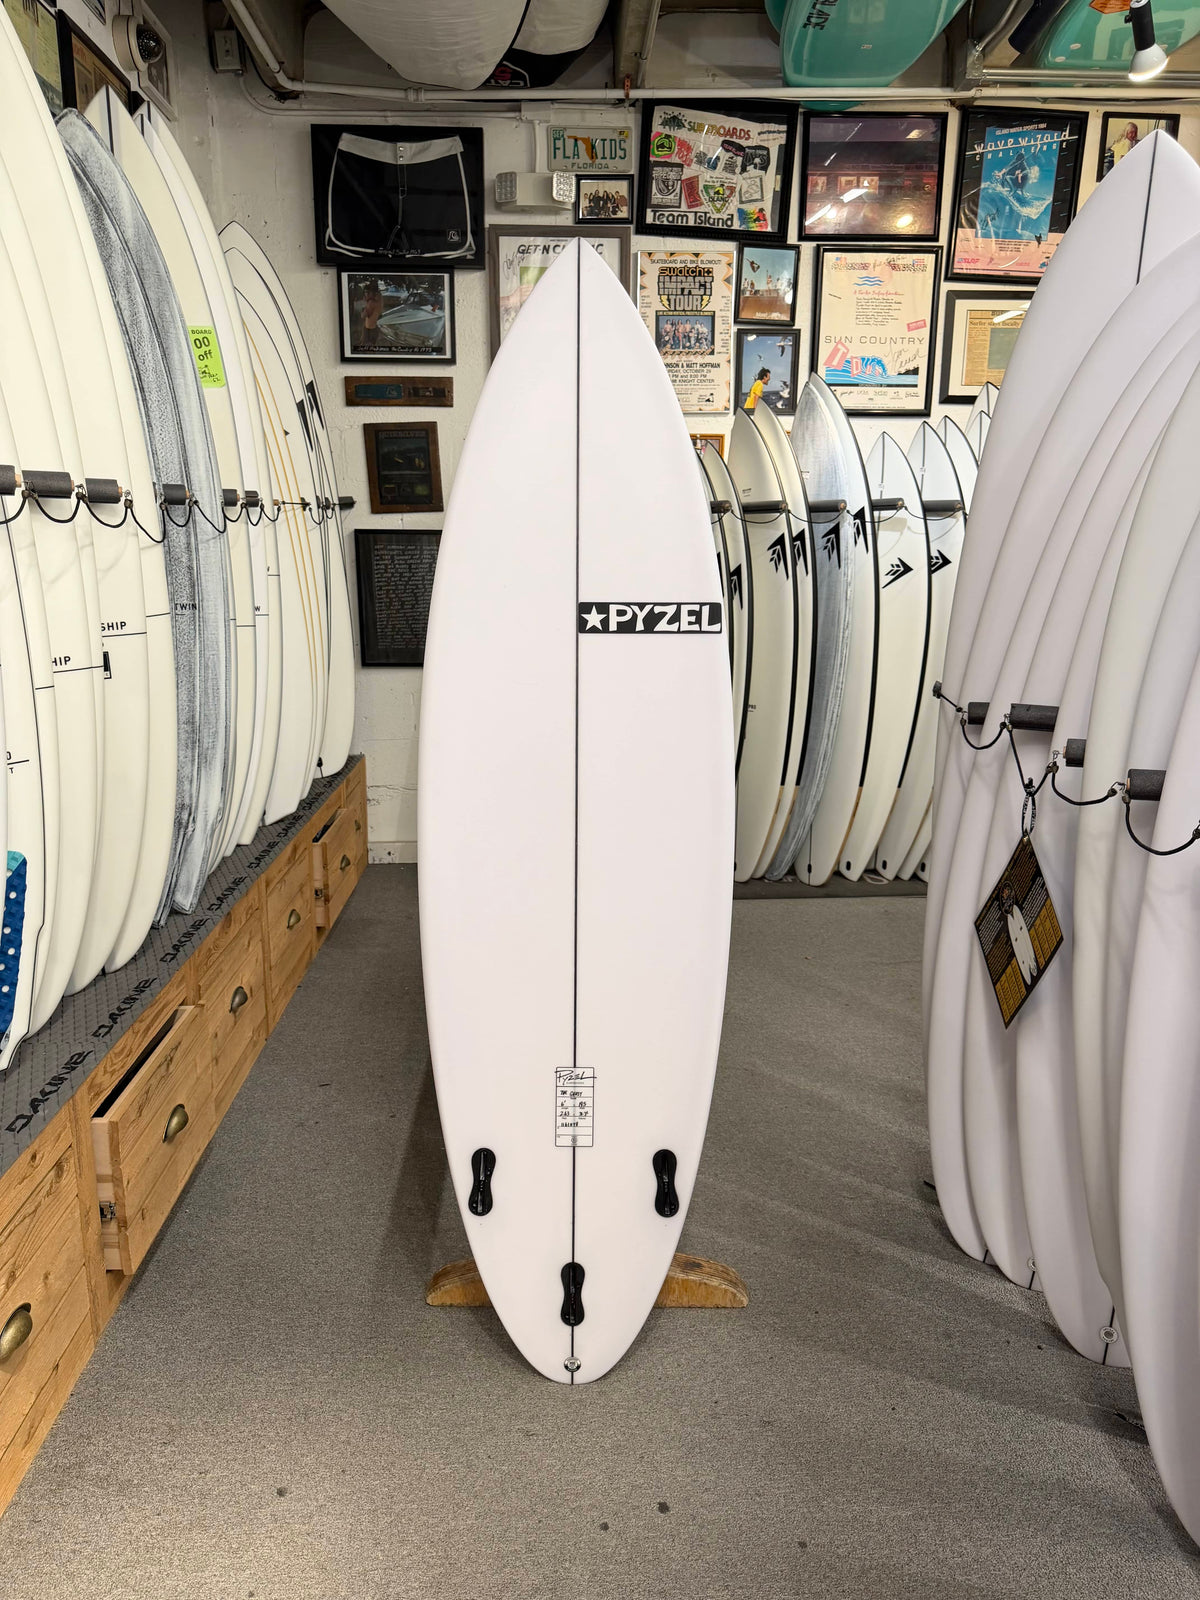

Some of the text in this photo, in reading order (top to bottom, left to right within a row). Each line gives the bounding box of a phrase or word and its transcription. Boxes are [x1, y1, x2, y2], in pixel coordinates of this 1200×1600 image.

[802, 0, 839, 30] LADE
[553, 138, 627, 160] FLA KIDS
[650, 209, 735, 228] Team Island
[657, 275, 714, 296] IMPACT
[669, 295, 702, 311] TOUR
[824, 335, 925, 345] SUN COUNTRY
[198, 349, 213, 361] off
[174, 603, 197, 611] TWIN
[608, 603, 721, 632] PYZEL
[52, 656, 71, 667] HIP
[160, 918, 210, 963] DAKINE
[91, 977, 157, 1038] DAKINE
[4, 1050, 93, 1133] DAKINE
